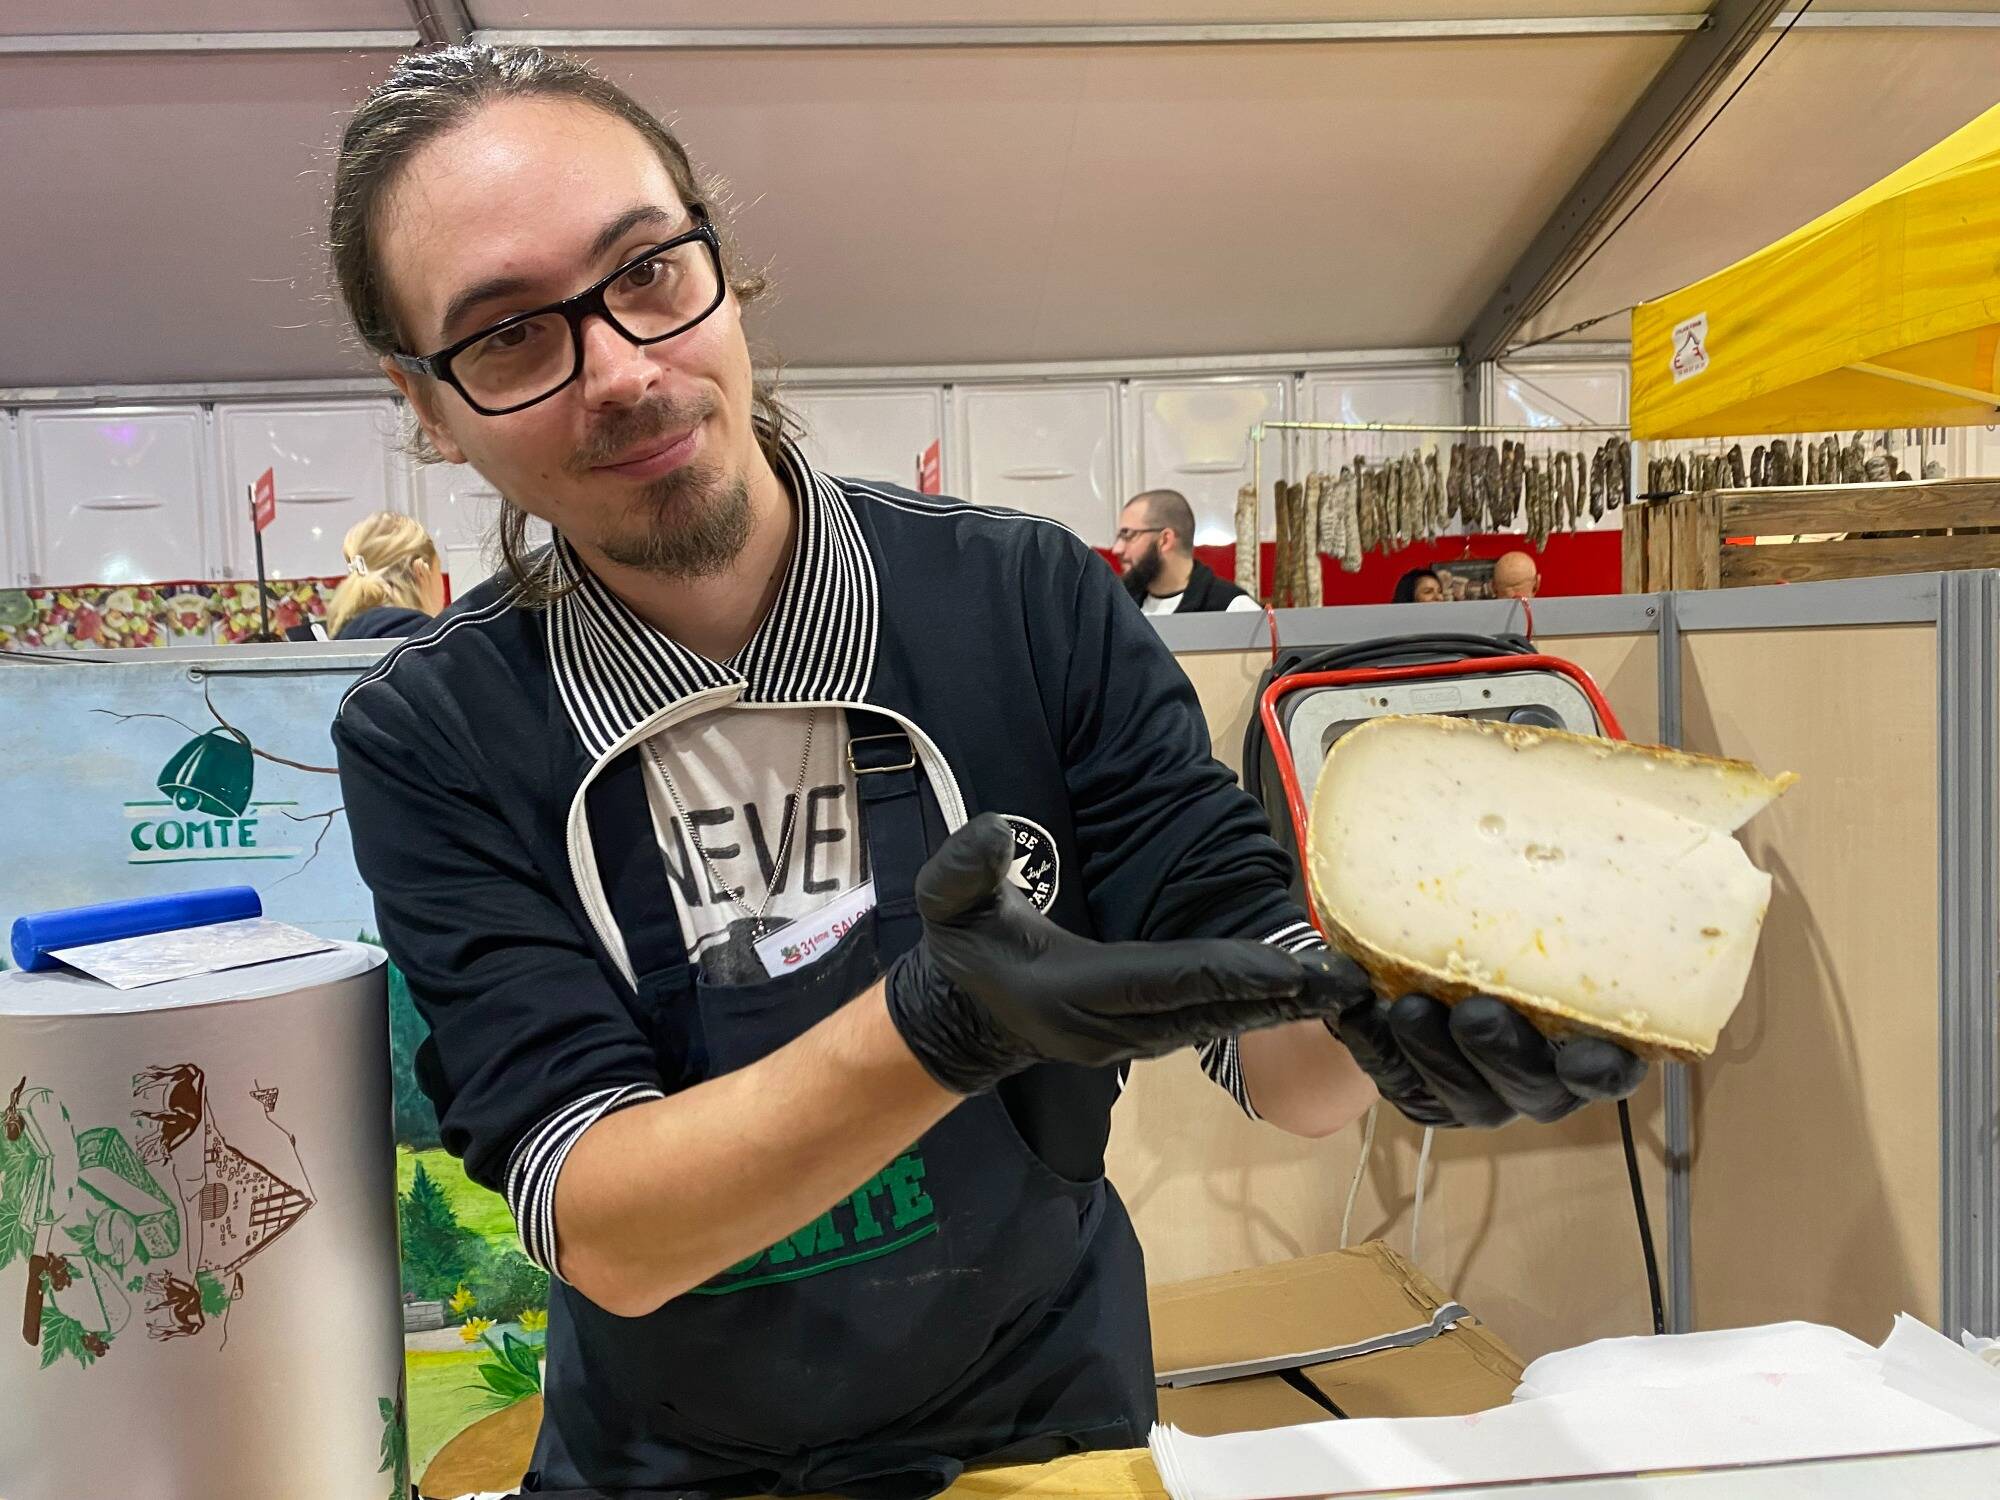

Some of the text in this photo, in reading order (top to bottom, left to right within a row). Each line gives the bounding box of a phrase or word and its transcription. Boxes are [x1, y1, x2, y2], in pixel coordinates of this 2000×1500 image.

[130, 809, 259, 852] COMTÉ
[660, 783, 873, 907] NEVE
[1026, 860, 1052, 880] Taylor
